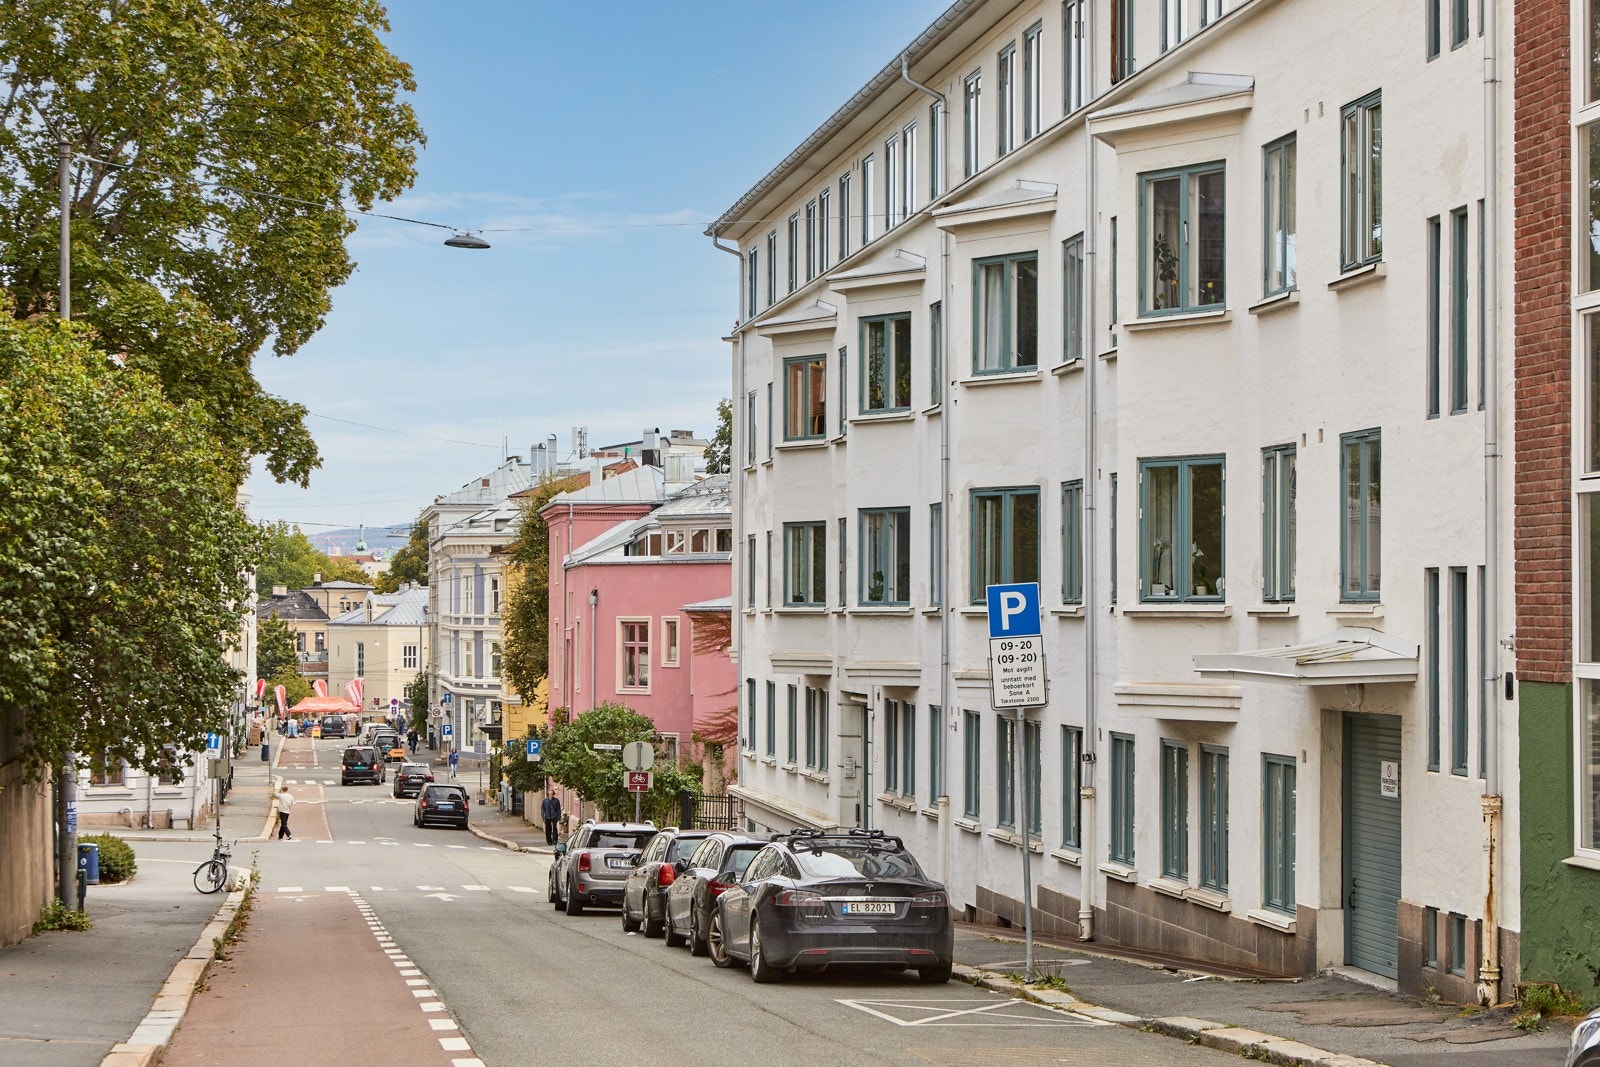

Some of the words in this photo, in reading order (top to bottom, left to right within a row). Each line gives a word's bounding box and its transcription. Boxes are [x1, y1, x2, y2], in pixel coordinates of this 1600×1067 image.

[1000, 592, 1026, 630] P
[1003, 682, 1035, 690] beboerkort
[444, 725, 451, 735] P
[530, 741, 539, 753] P
[850, 903, 861, 912] EL
[864, 903, 892, 912] 82021
